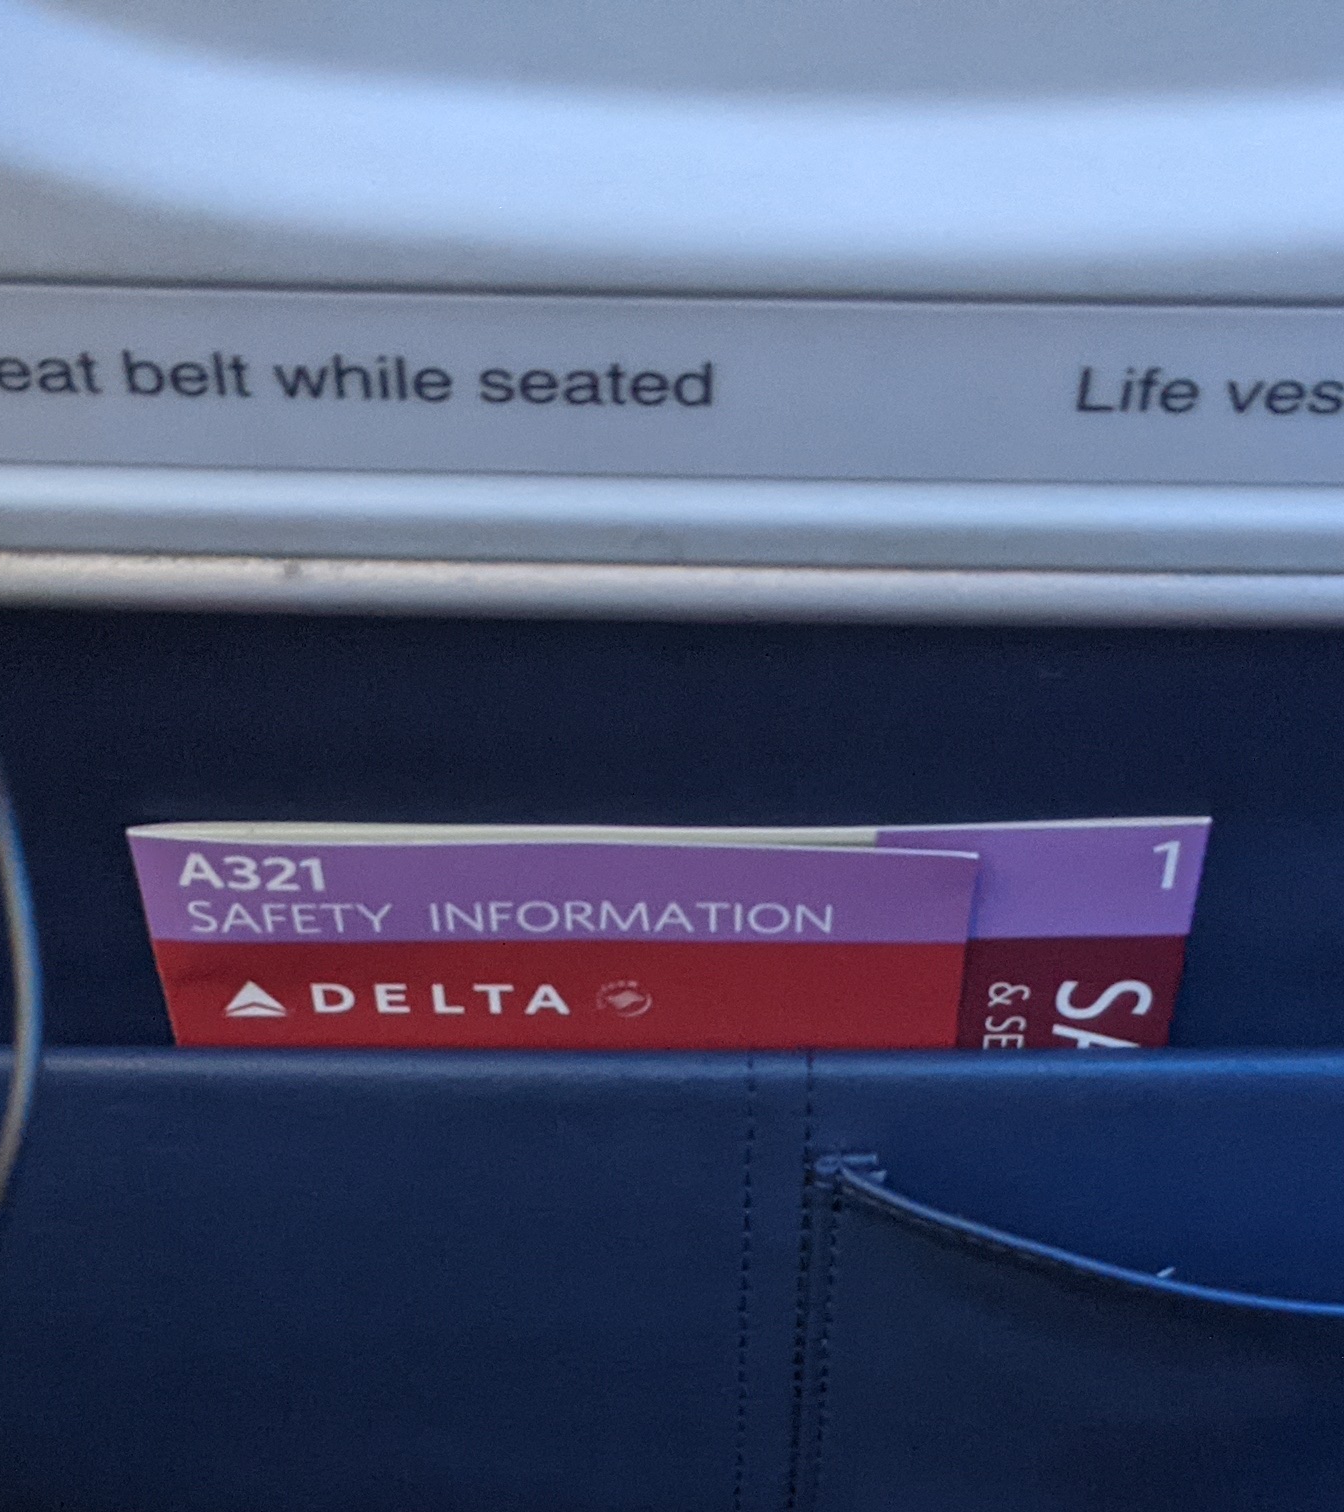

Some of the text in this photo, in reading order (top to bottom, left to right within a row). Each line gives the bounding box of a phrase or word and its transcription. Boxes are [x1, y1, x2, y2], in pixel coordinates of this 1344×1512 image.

[120, 349, 252, 398] belt
[273, 353, 453, 402] while
[478, 360, 715, 407] seated
[1075, 366, 1201, 415] Life
[178, 852, 326, 892] A321
[1152, 840, 1181, 890] 1
[186, 899, 833, 934] SAFETY INFORMATION
[309, 983, 571, 1015] DELTA
[987, 981, 1031, 1008] &
